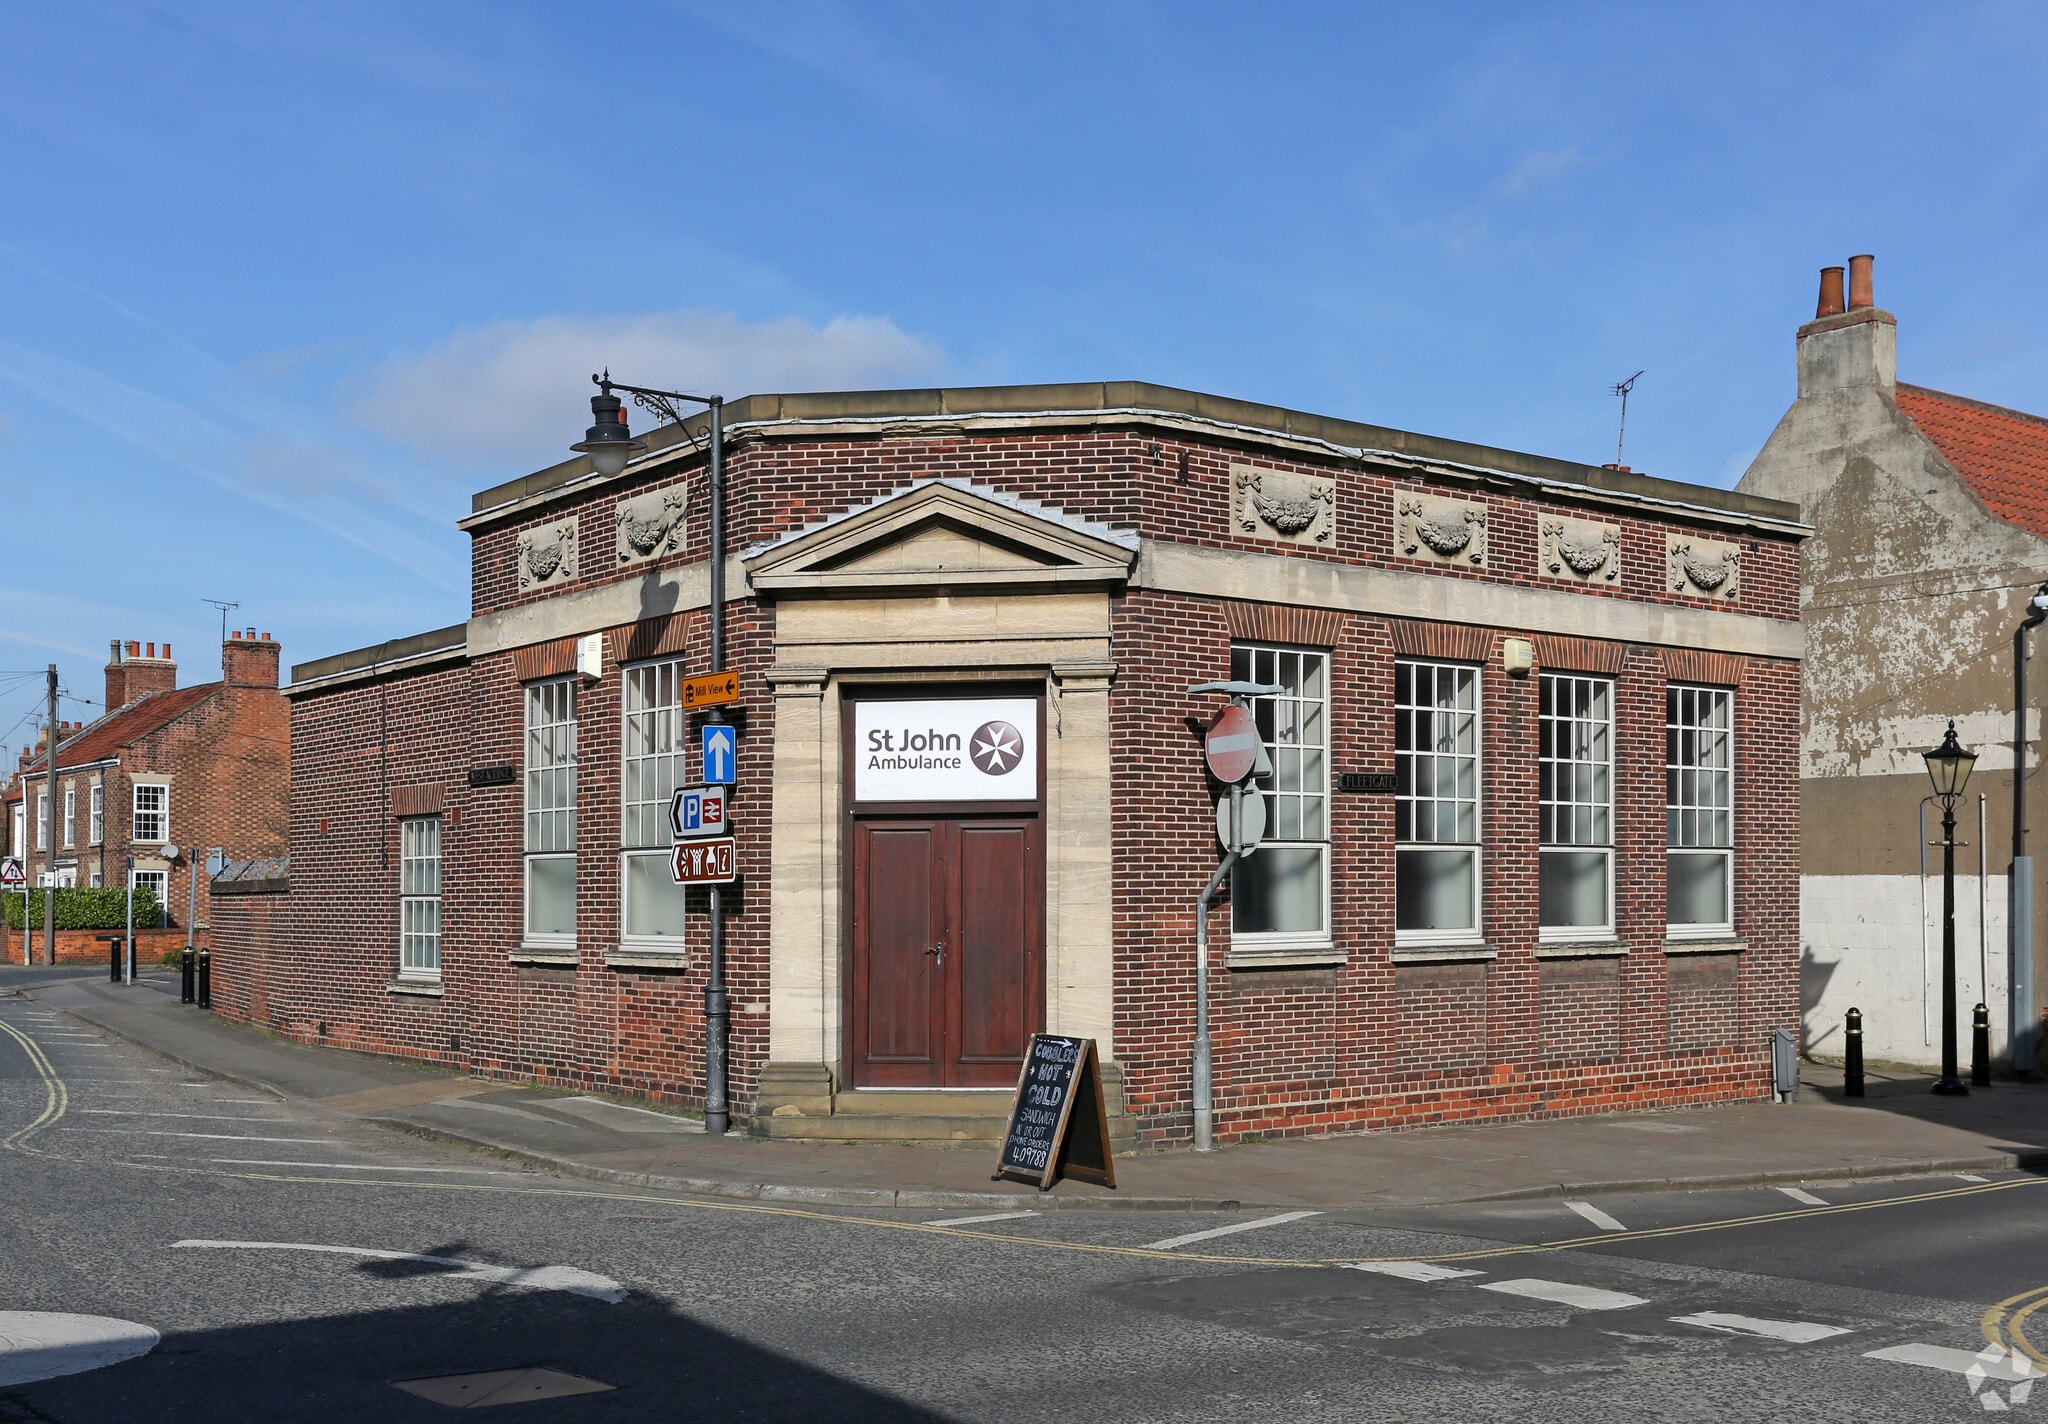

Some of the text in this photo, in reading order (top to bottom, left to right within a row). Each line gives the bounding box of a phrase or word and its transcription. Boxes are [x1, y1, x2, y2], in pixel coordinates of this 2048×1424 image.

[695, 683, 724, 697] Mill View
[868, 728, 960, 752] St John
[868, 755, 961, 770] Ambulance
[1346, 775, 1394, 788] FLEETGATE
[688, 798, 698, 826] P
[1038, 1064, 1064, 1080] HOT
[1028, 1084, 1062, 1106] COLD
[1020, 1108, 1056, 1126] SANDWICH
[1012, 1146, 1046, 1168] 409788
